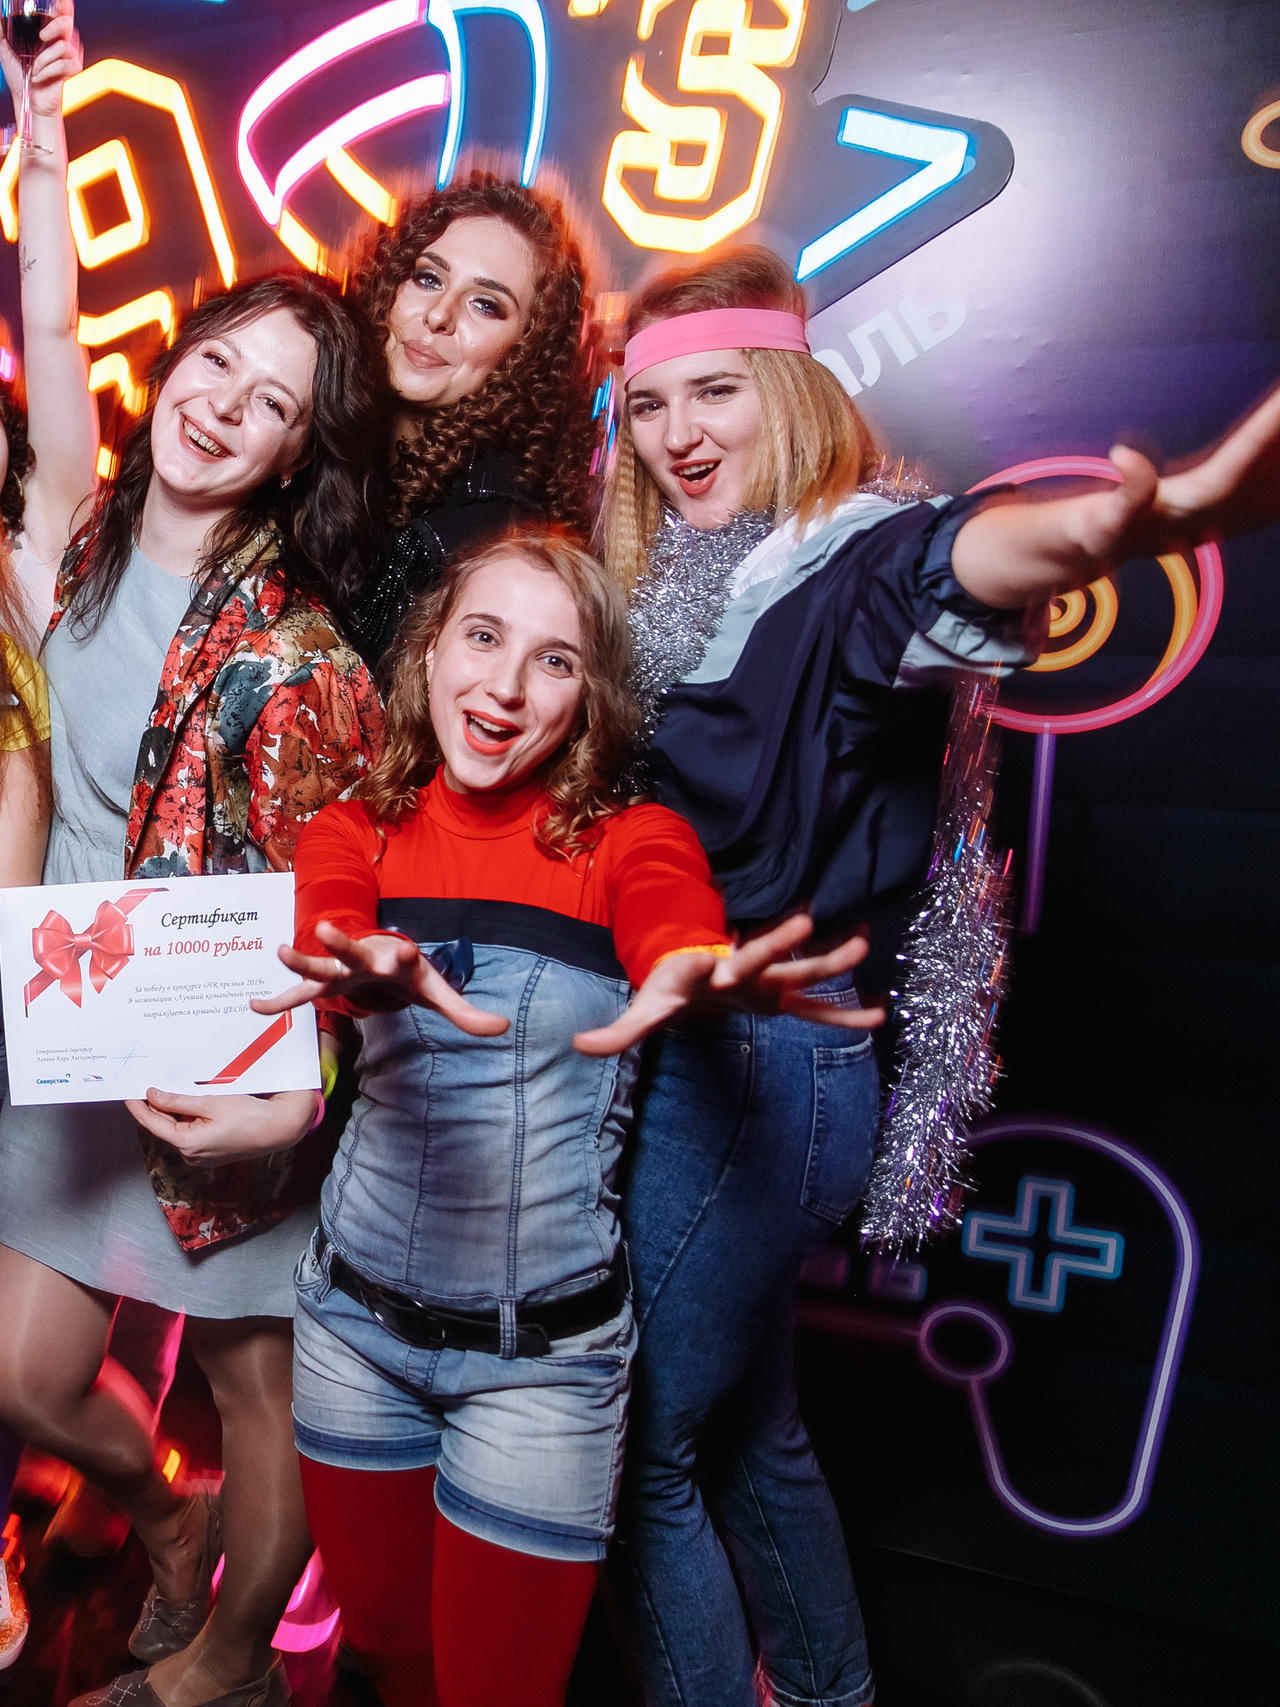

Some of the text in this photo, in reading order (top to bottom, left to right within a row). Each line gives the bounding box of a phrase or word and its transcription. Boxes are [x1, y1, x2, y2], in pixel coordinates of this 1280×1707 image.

[161, 908, 259, 930] Сертификат
[143, 936, 264, 957] на 10000 рублей
[133, 986, 142, 994] За
[144, 984, 166, 994] победу
[172, 983, 202, 992] конкурсе
[220, 981, 245, 990] премия
[246, 979, 265, 987] 2019»
[135, 996, 173, 1004] номинации
[205, 990, 244, 1001] командный
[245, 990, 273, 999] проект»
[143, 1009, 191, 1020] награждается
[192, 1006, 221, 1017] команда
